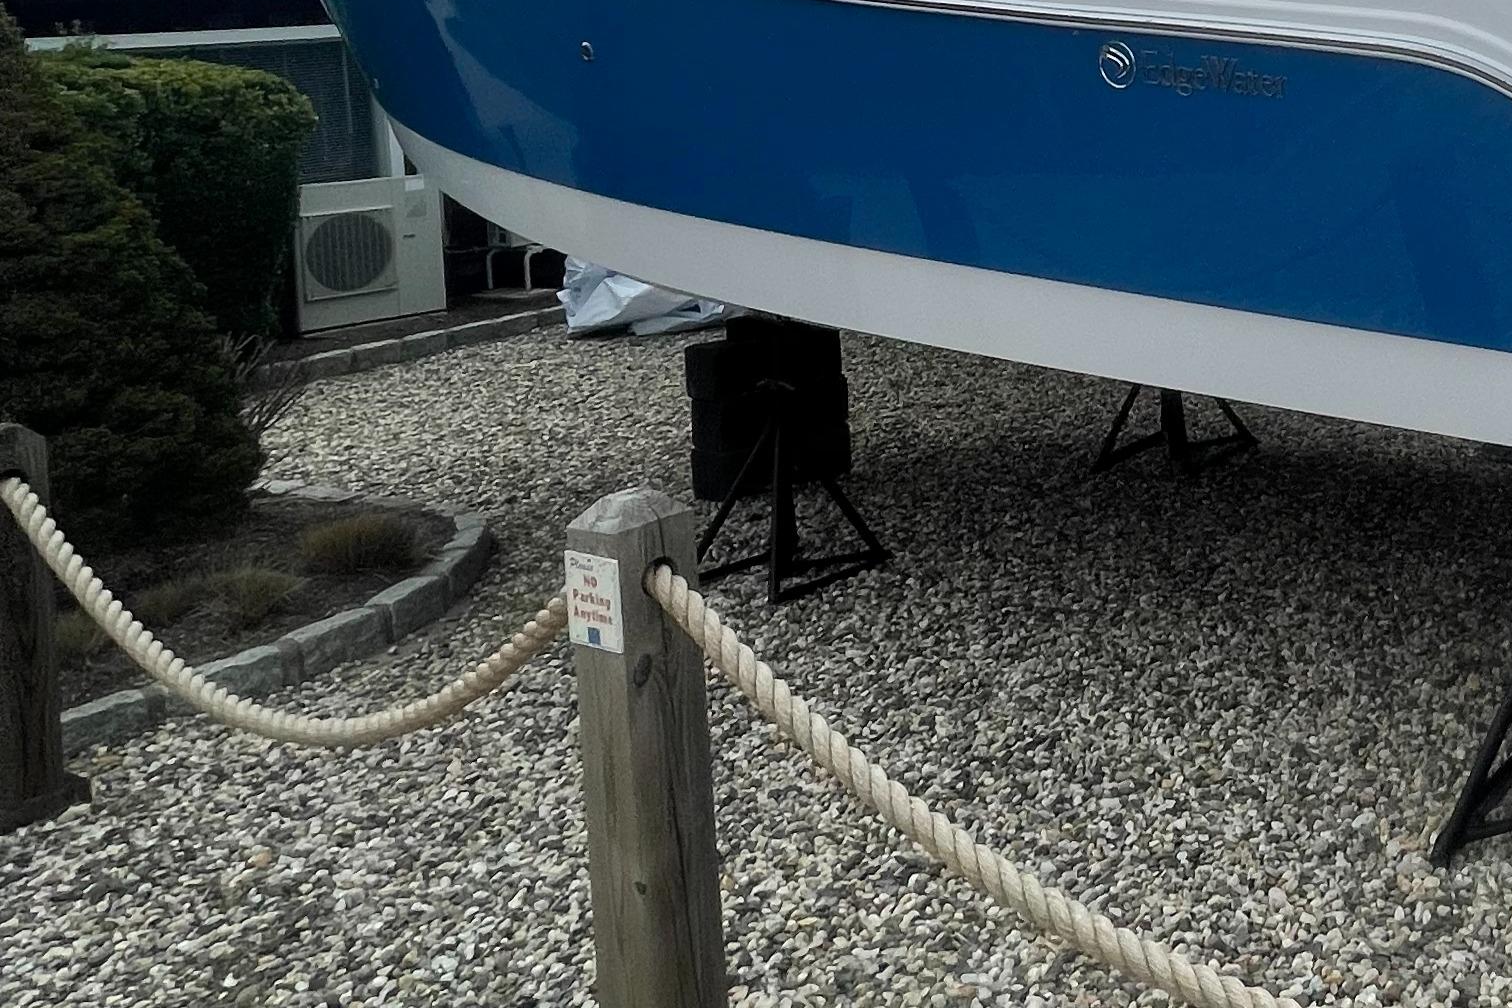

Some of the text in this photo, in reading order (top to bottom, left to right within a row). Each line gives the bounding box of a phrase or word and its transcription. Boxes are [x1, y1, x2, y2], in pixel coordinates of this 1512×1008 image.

[1141, 49, 1288, 98] EdgeWater
[572, 588, 611, 611] Parking
[573, 605, 613, 626] Anytime
